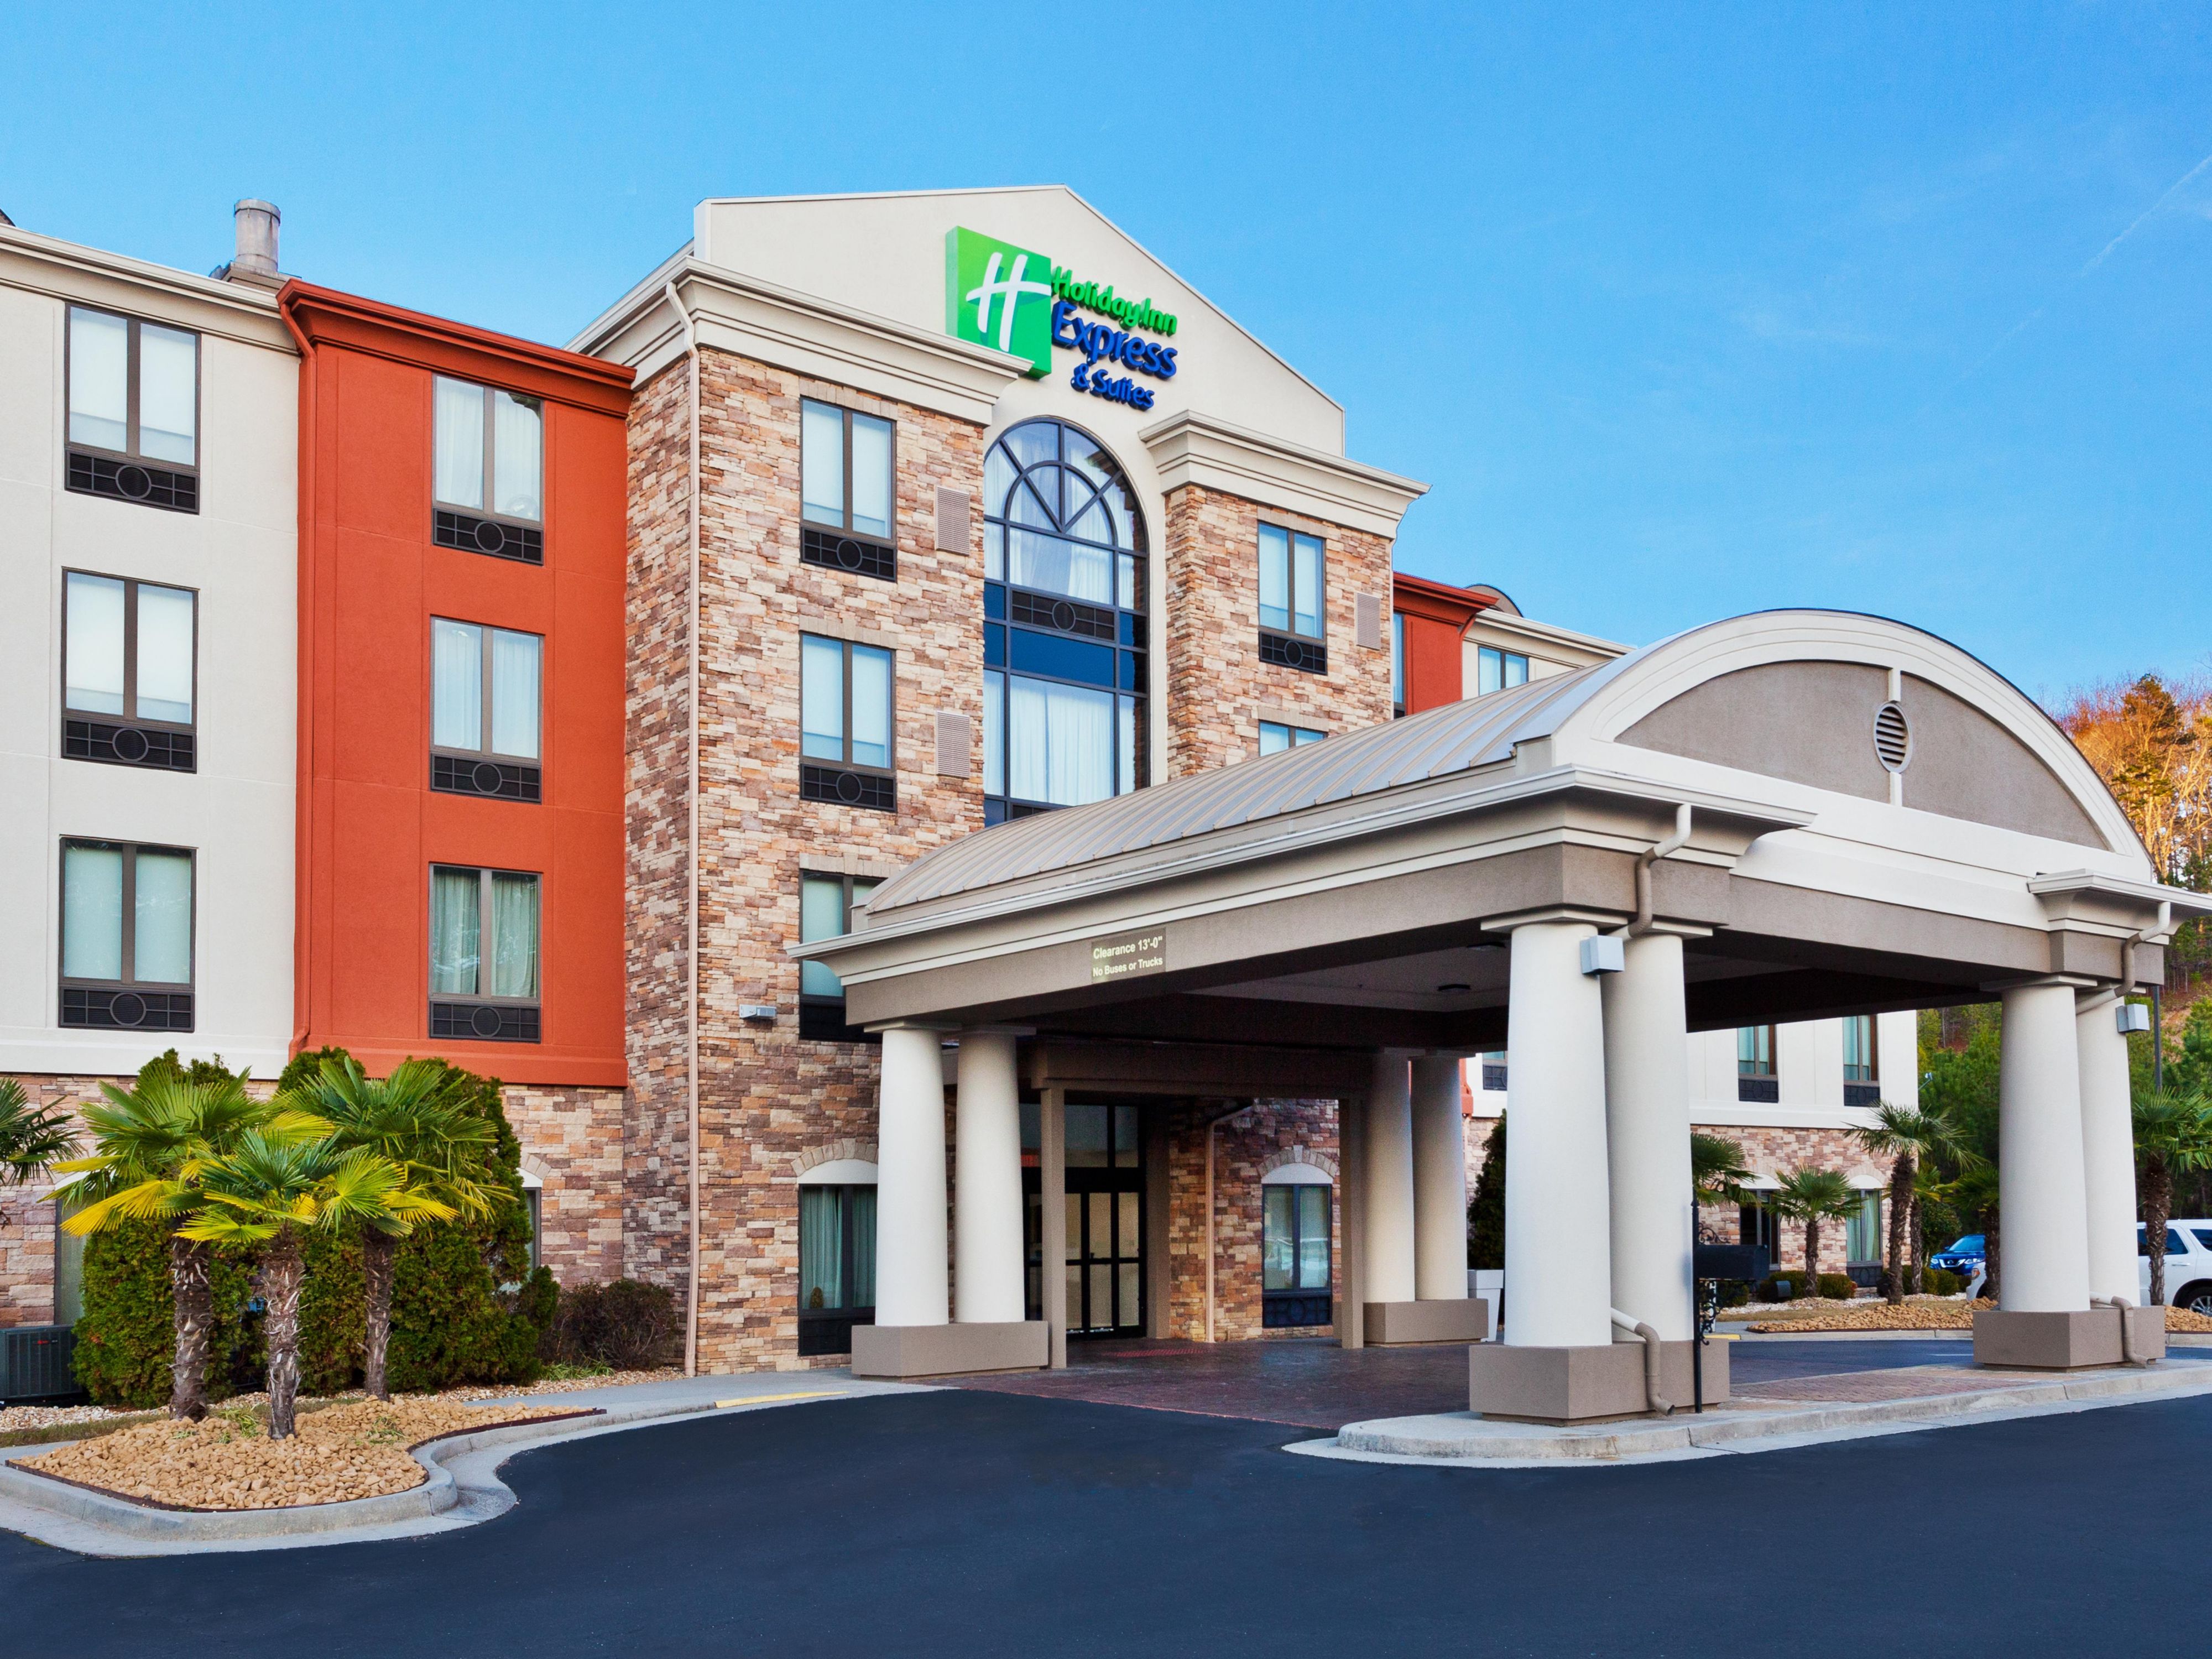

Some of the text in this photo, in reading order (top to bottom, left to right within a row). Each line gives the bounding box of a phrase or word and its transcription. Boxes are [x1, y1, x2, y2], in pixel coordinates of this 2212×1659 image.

[1051, 266, 1177, 336] Holiday Inn
[1052, 301, 1177, 380] Express
[1071, 363, 1154, 410] & Suites
[1093, 936, 1162, 959] Clearance 13'-0"
[1093, 967, 1103, 977] No
[1104, 964, 1127, 974] Buses
[1138, 957, 1163, 968] Trucks
